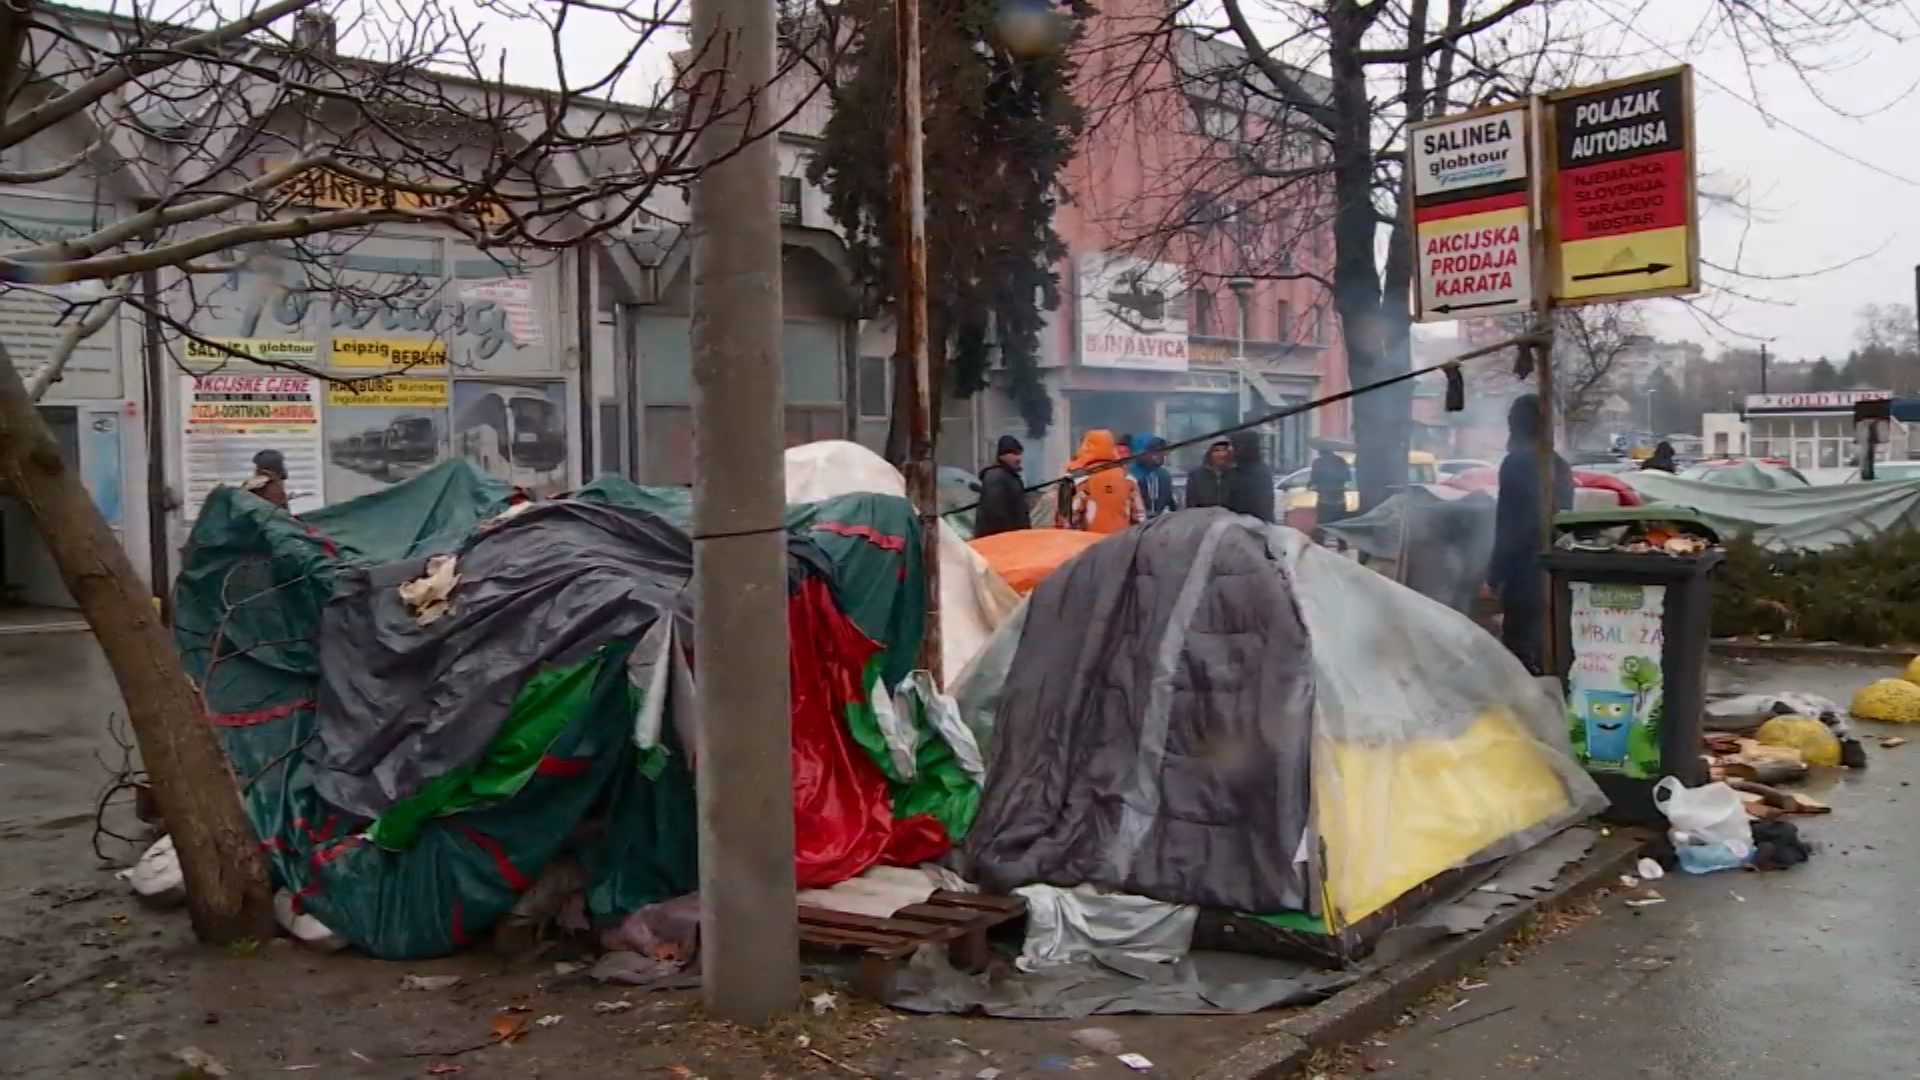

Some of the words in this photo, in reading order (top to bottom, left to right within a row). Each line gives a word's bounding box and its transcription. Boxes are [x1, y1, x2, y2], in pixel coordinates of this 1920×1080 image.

[1575, 89, 1662, 128] POLAZAK
[1423, 119, 1512, 155] SALINEA
[1571, 119, 1668, 160] AUTOBUSA
[1430, 148, 1510, 176] globtour
[1575, 161, 1666, 187] NJEMAČKA
[1575, 179, 1666, 203] SLOVENIJA
[1577, 195, 1665, 218] SARAJEVO
[1587, 213, 1656, 232] MOSTAR
[1427, 225, 1520, 256] AKCIJSKA
[1430, 248, 1517, 276] PRODAJA
[1435, 271, 1512, 298] KARATA
[258, 341, 316, 355] globtour
[332, 339, 389, 358] Leipzig
[391, 349, 447, 366] BERLIN
